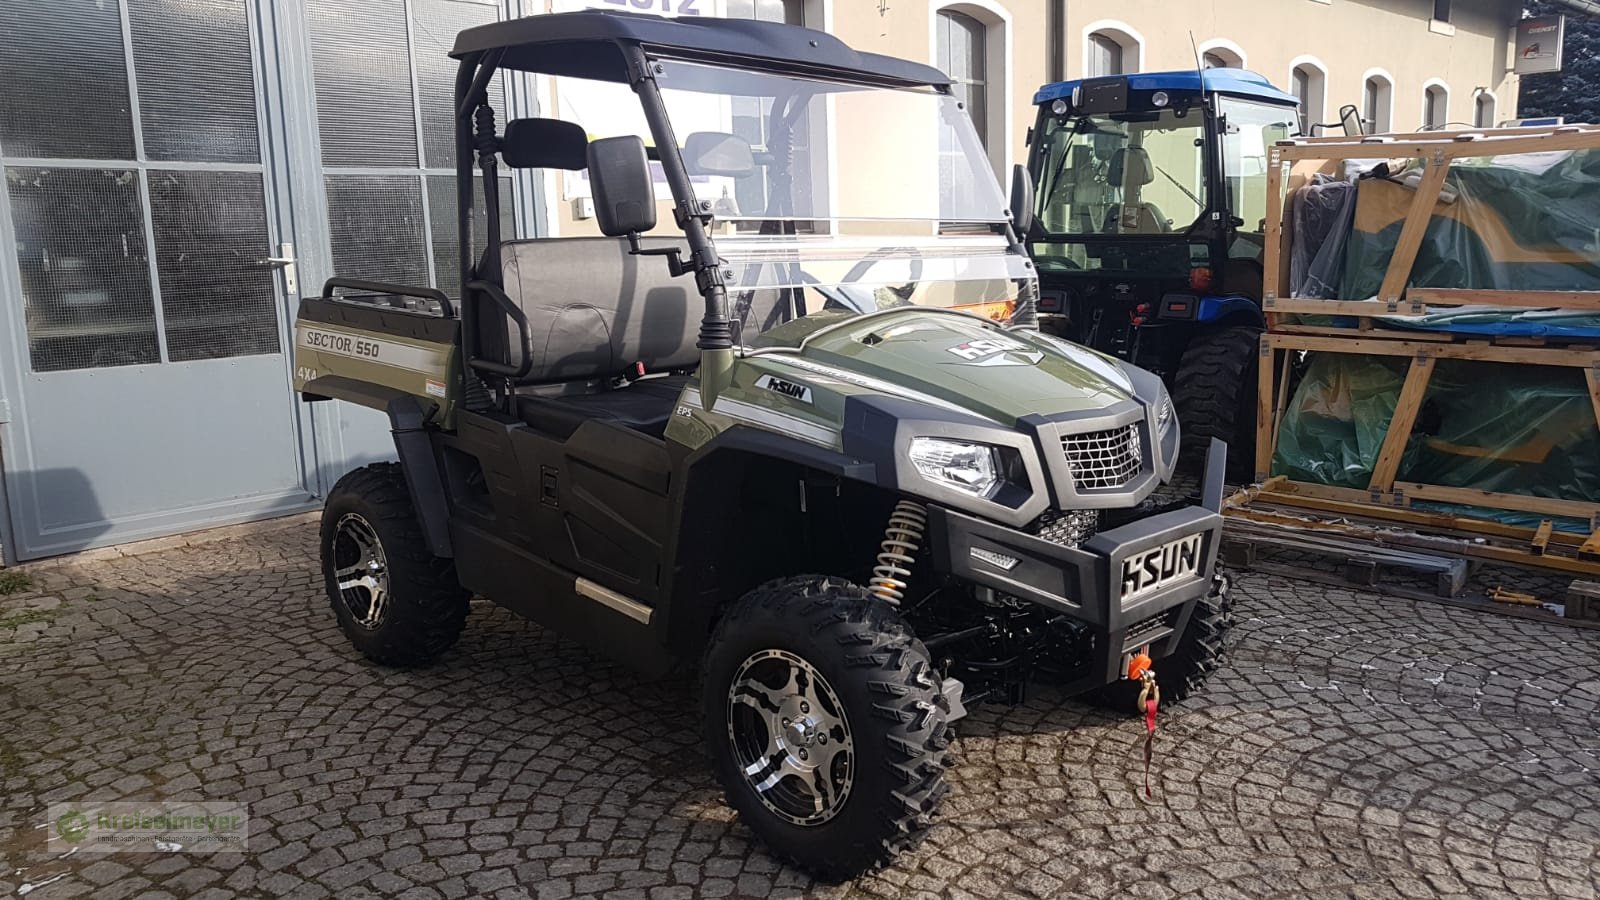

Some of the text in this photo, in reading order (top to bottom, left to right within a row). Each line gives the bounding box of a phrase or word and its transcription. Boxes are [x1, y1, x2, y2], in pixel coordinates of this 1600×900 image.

[306, 331, 379, 358] SECTOR 550
[676, 406, 693, 417] EPS
